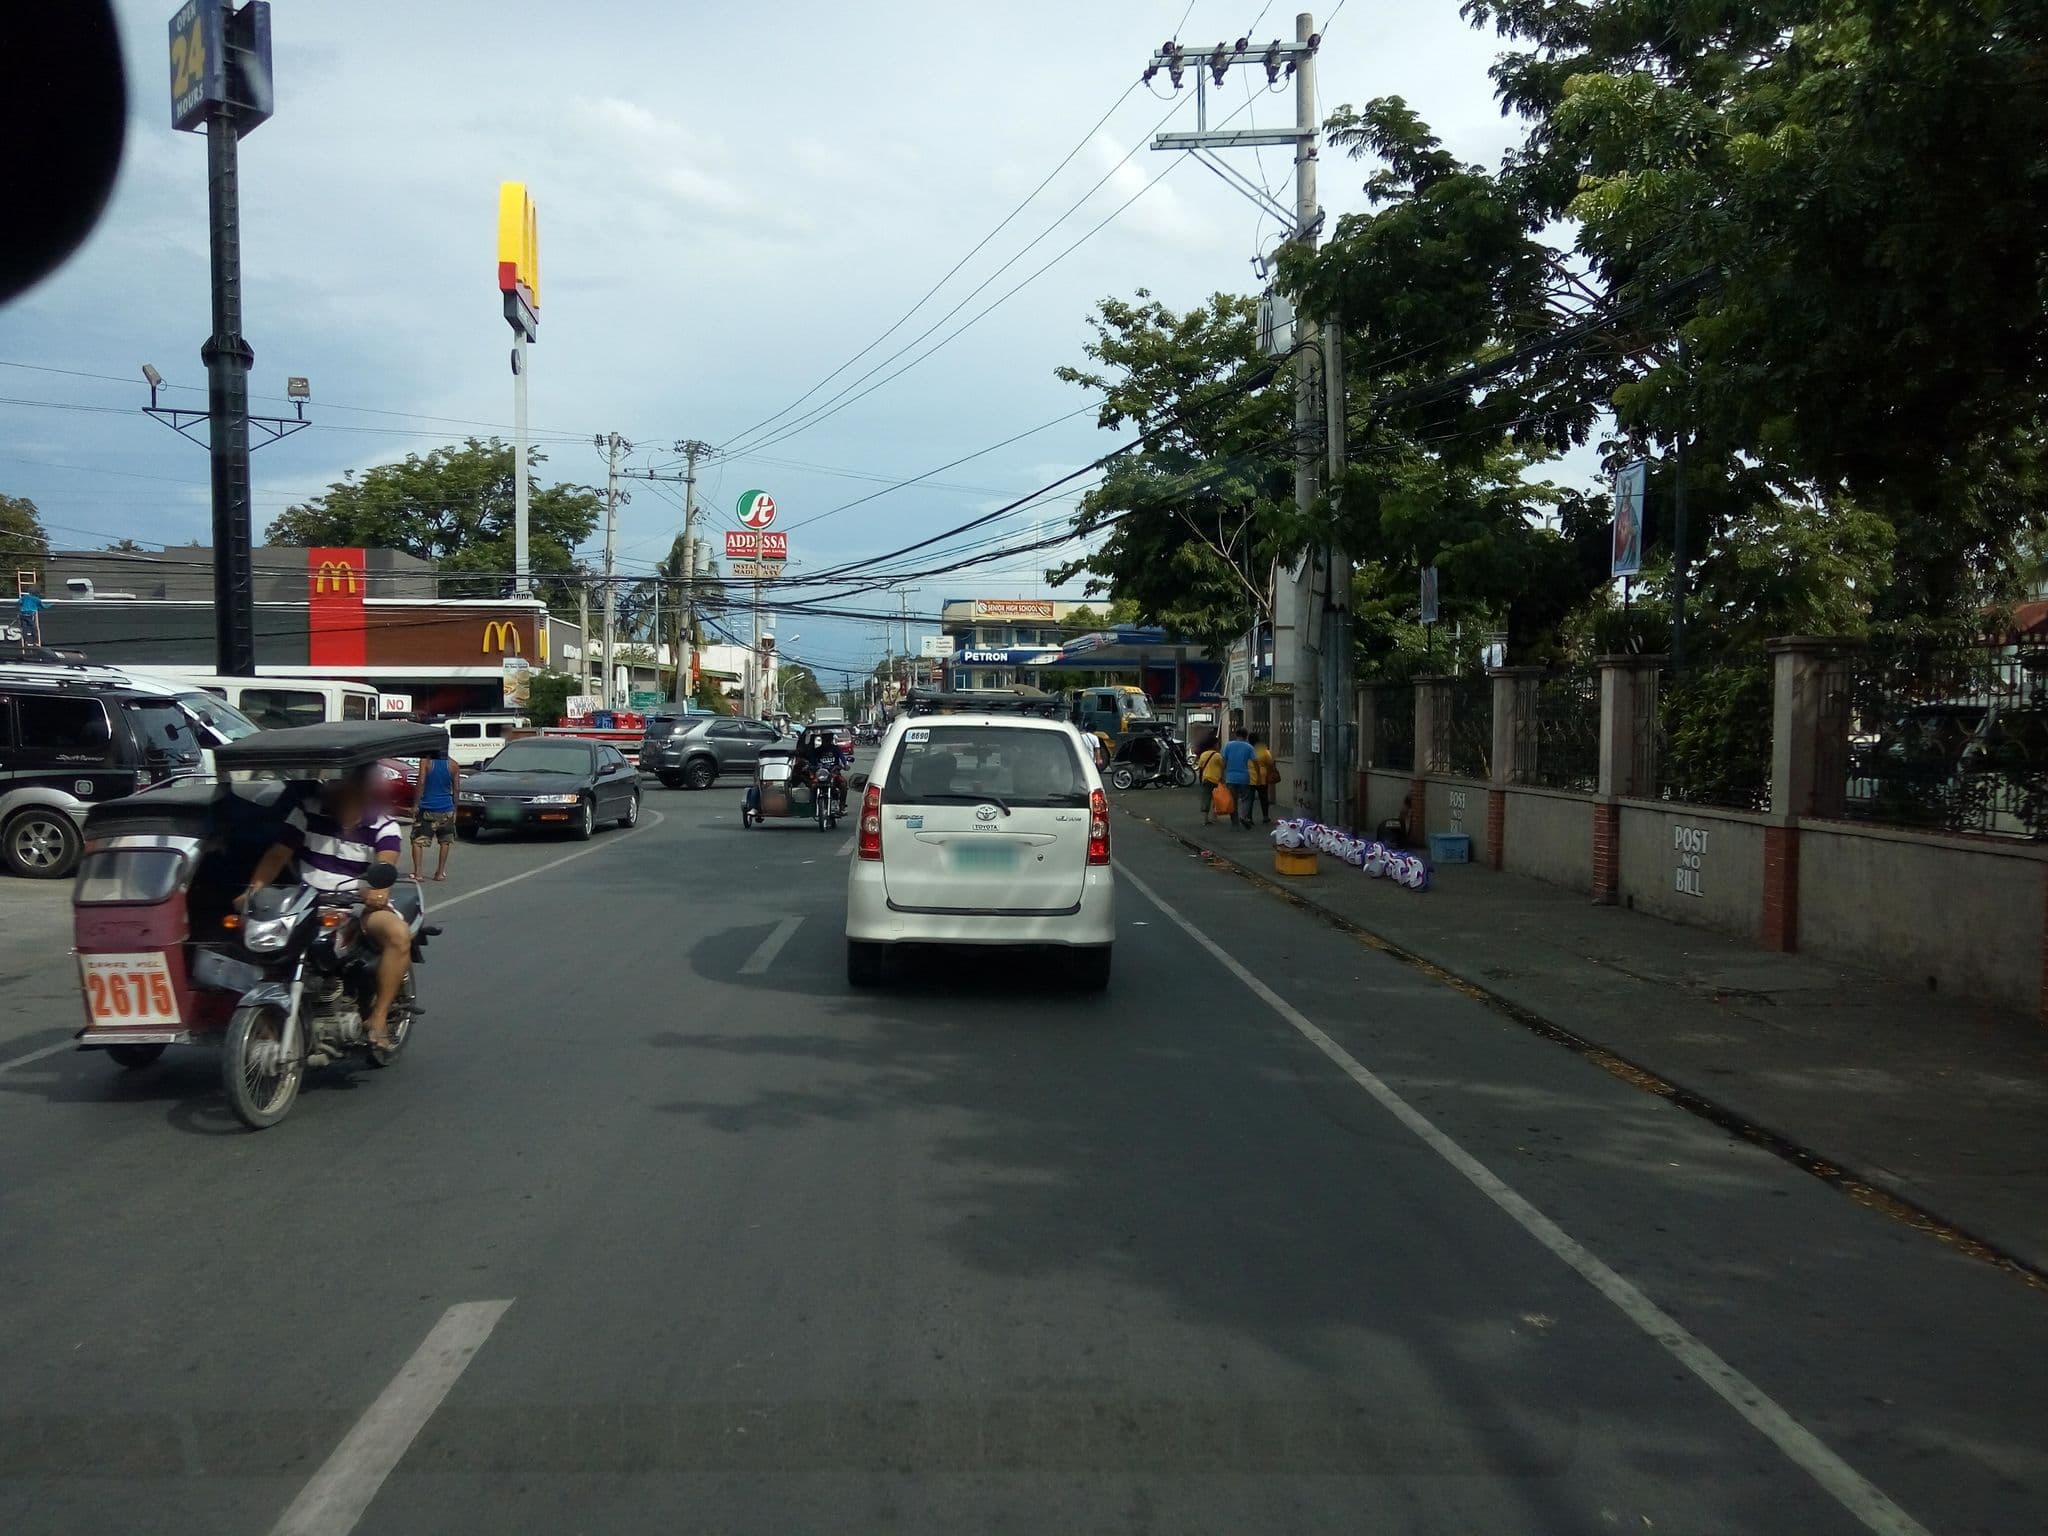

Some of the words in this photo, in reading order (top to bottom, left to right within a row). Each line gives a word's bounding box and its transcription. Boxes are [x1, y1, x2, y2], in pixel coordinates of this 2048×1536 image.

[176, 6, 196, 32] OPEN
[171, 15, 206, 99] 24
[176, 82, 205, 119] HOURS
[987, 604, 1005, 612] SENIOR
[1005, 604, 1018, 612] HIGH
[964, 651, 1008, 662] PETRON
[386, 699, 404, 710] NO
[1674, 826, 1709, 854] POST
[1682, 852, 1701, 870] NO
[1676, 867, 1705, 897] BILL
[87, 972, 173, 1017] 2675
